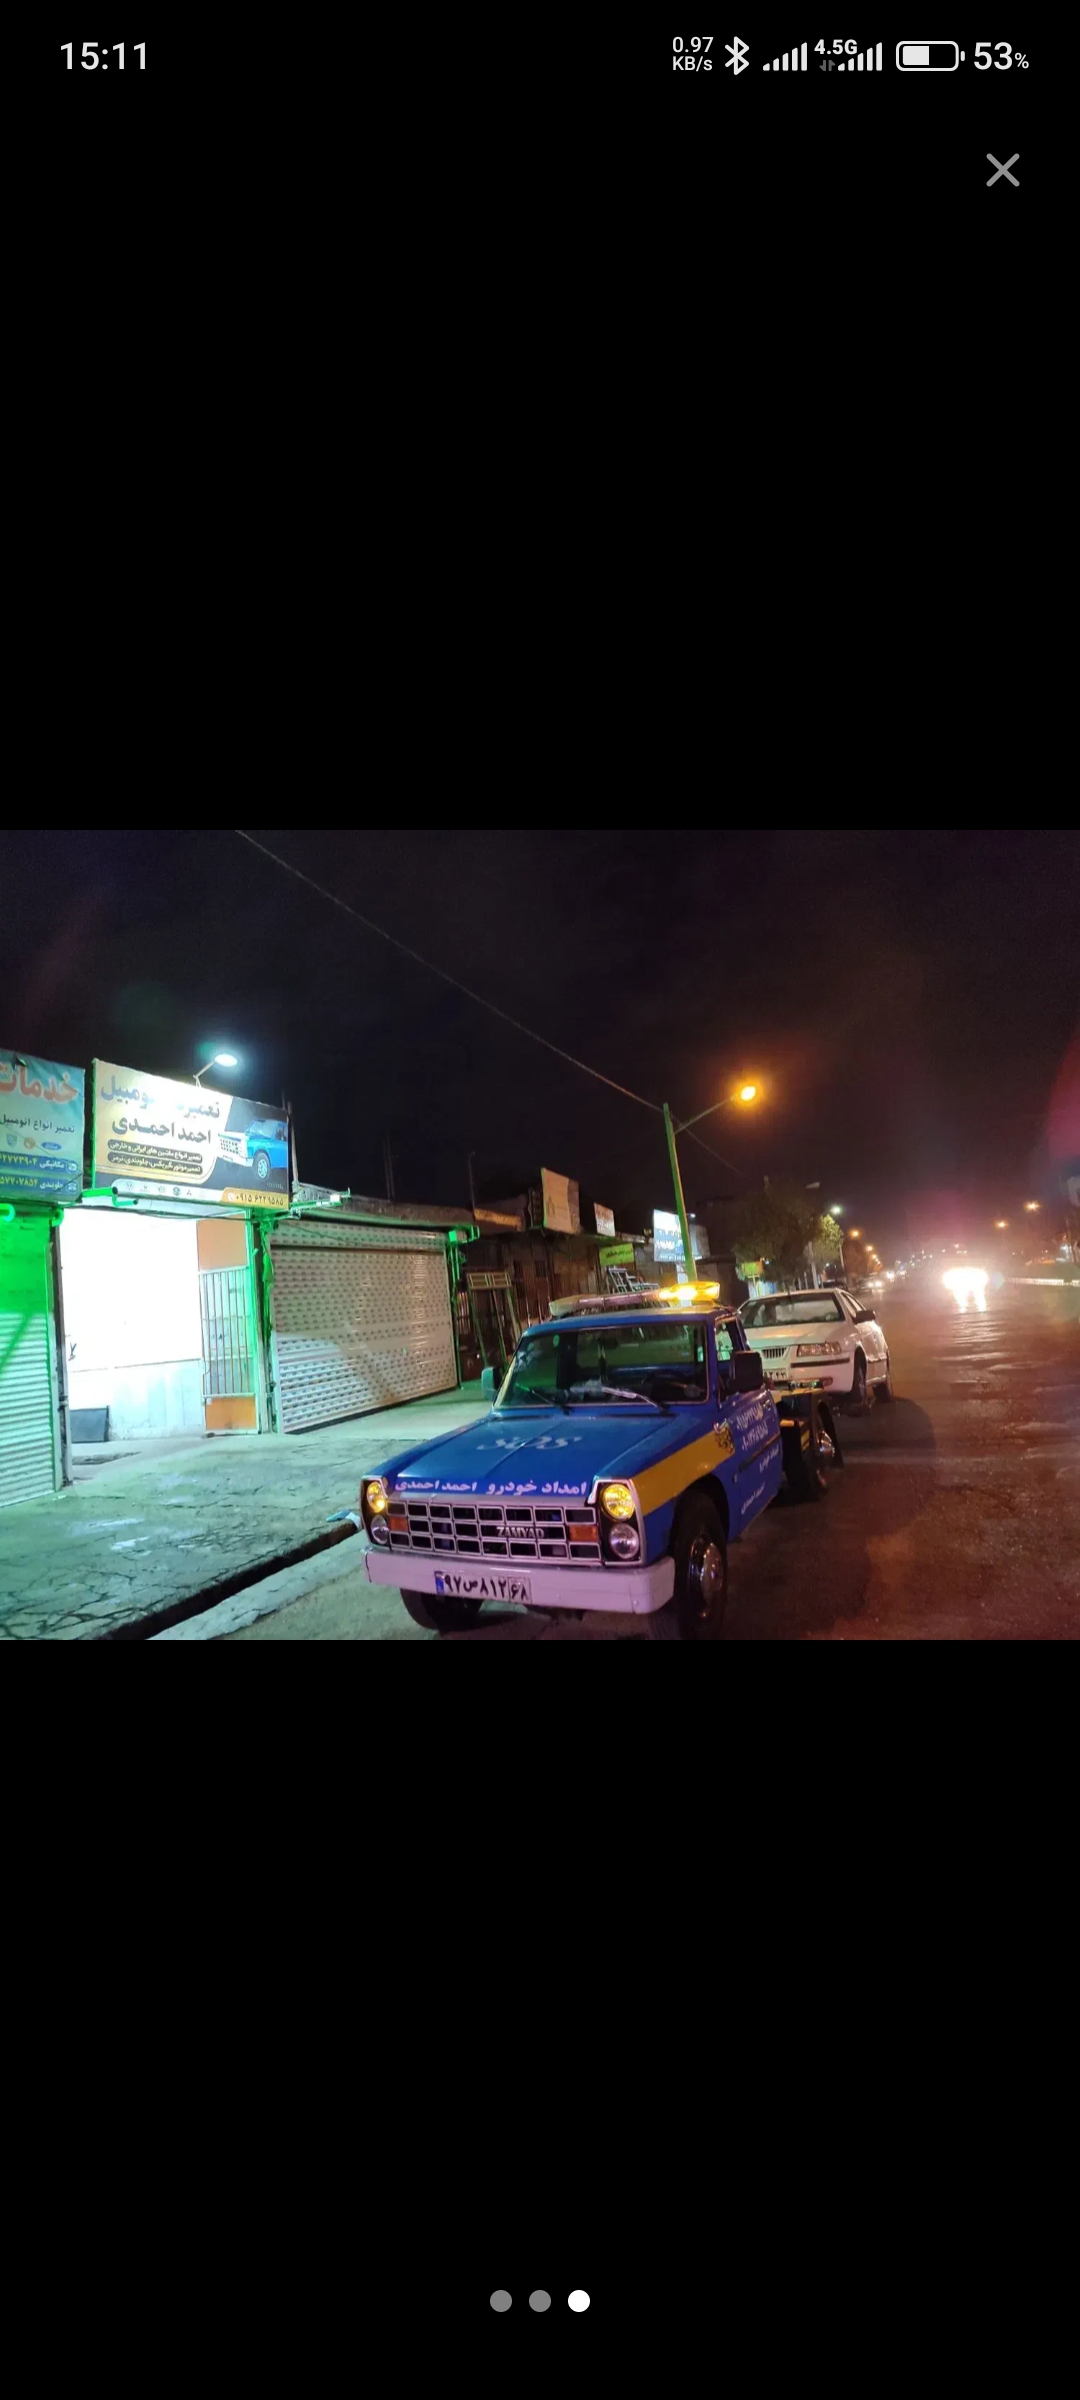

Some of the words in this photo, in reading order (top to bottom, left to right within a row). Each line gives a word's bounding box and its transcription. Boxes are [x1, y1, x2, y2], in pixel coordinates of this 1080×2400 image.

[33, 1120, 53, 1131] انواع
[112, 1117, 175, 1138] احمدی
[178, 1127, 211, 1144] احمد
[39, 1160, 65, 1169] مکانیکی
[394, 1480, 440, 1491] احمدی
[441, 1481, 477, 1492] احمد
[485, 1479, 537, 1496] خودرو
[541, 1481, 587, 1495] امداد
[496, 1526, 545, 1539] ZAMYAD
